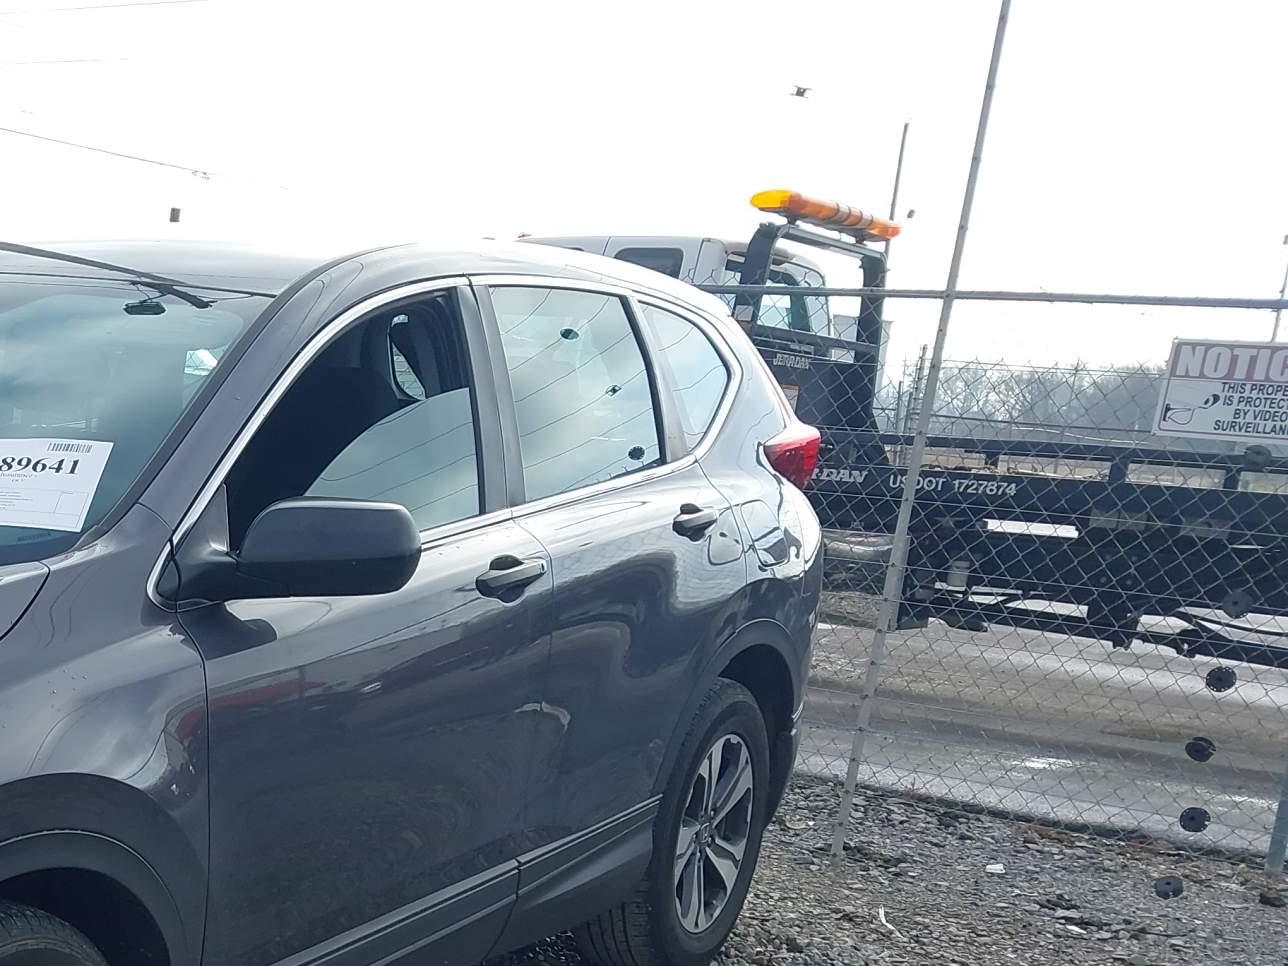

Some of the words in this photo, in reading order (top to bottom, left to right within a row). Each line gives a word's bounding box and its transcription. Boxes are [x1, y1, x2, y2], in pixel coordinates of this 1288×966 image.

[1175, 345, 1288, 381] NOTIC
[1221, 382, 1247, 395] THIS
[1223, 395, 1234, 406] IS
[1233, 408, 1250, 420] BY
[1253, 410, 1288, 423] VIDEO
[1213, 420, 1288, 436] SURVEILLAN
[952, 479, 1017, 496] 1727874
